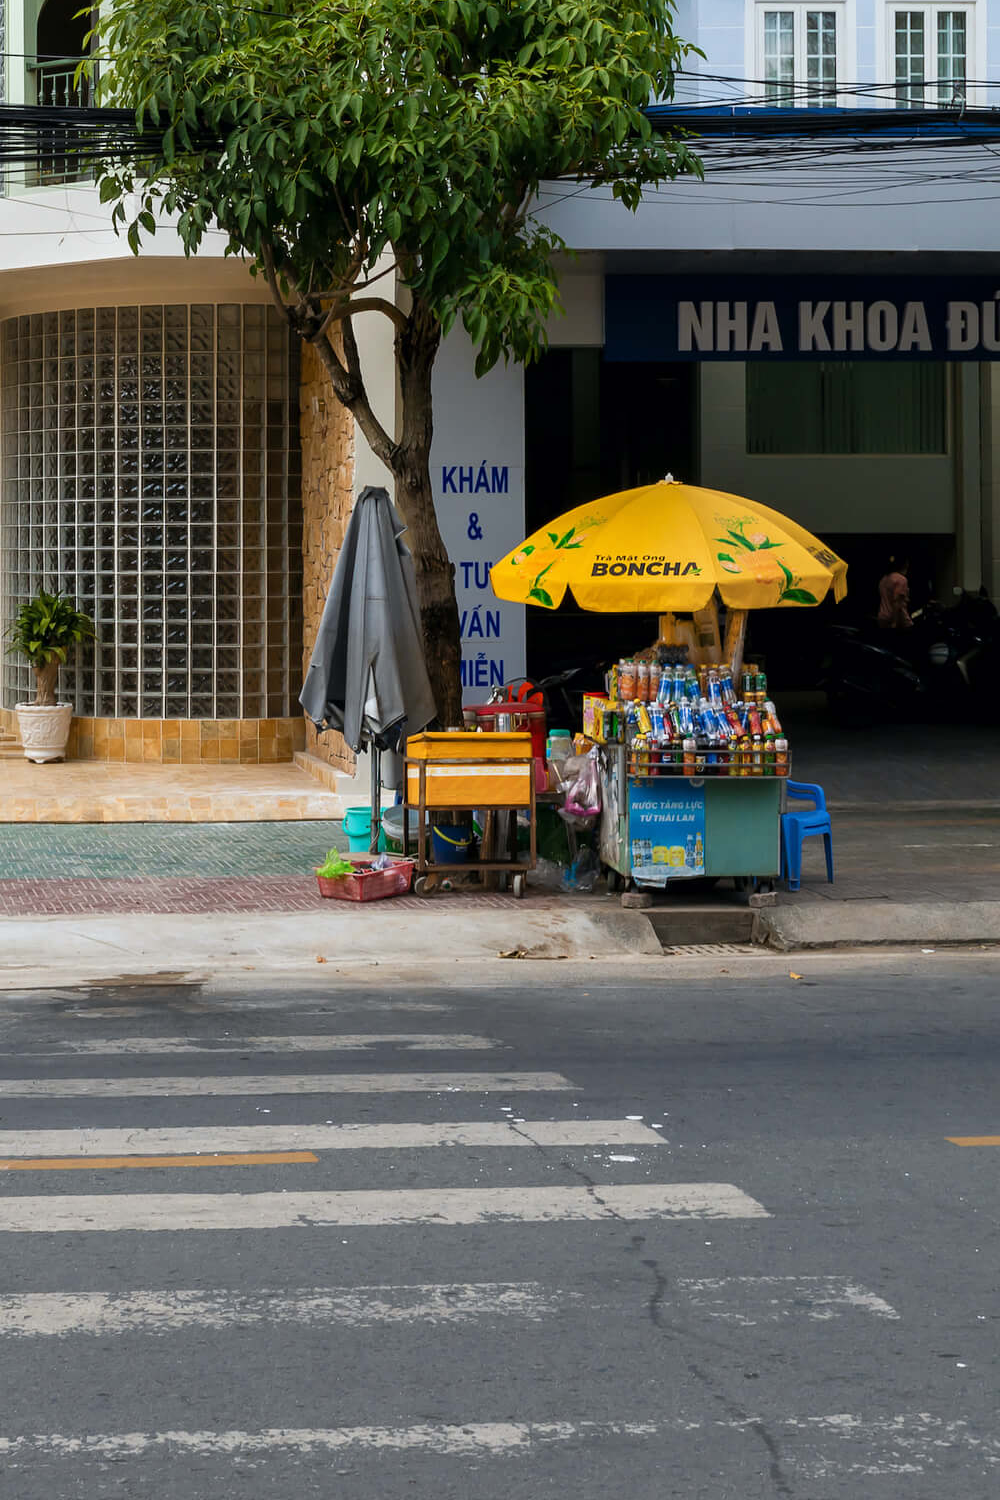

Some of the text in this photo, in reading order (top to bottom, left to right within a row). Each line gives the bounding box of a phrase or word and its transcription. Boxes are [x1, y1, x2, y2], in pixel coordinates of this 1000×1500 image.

[677, 300, 784, 351] NHA
[798, 300, 933, 351] KHOA
[442, 460, 509, 493] KHÁM
[467, 512, 483, 540] &
[591, 562, 702, 577] BONCHA
